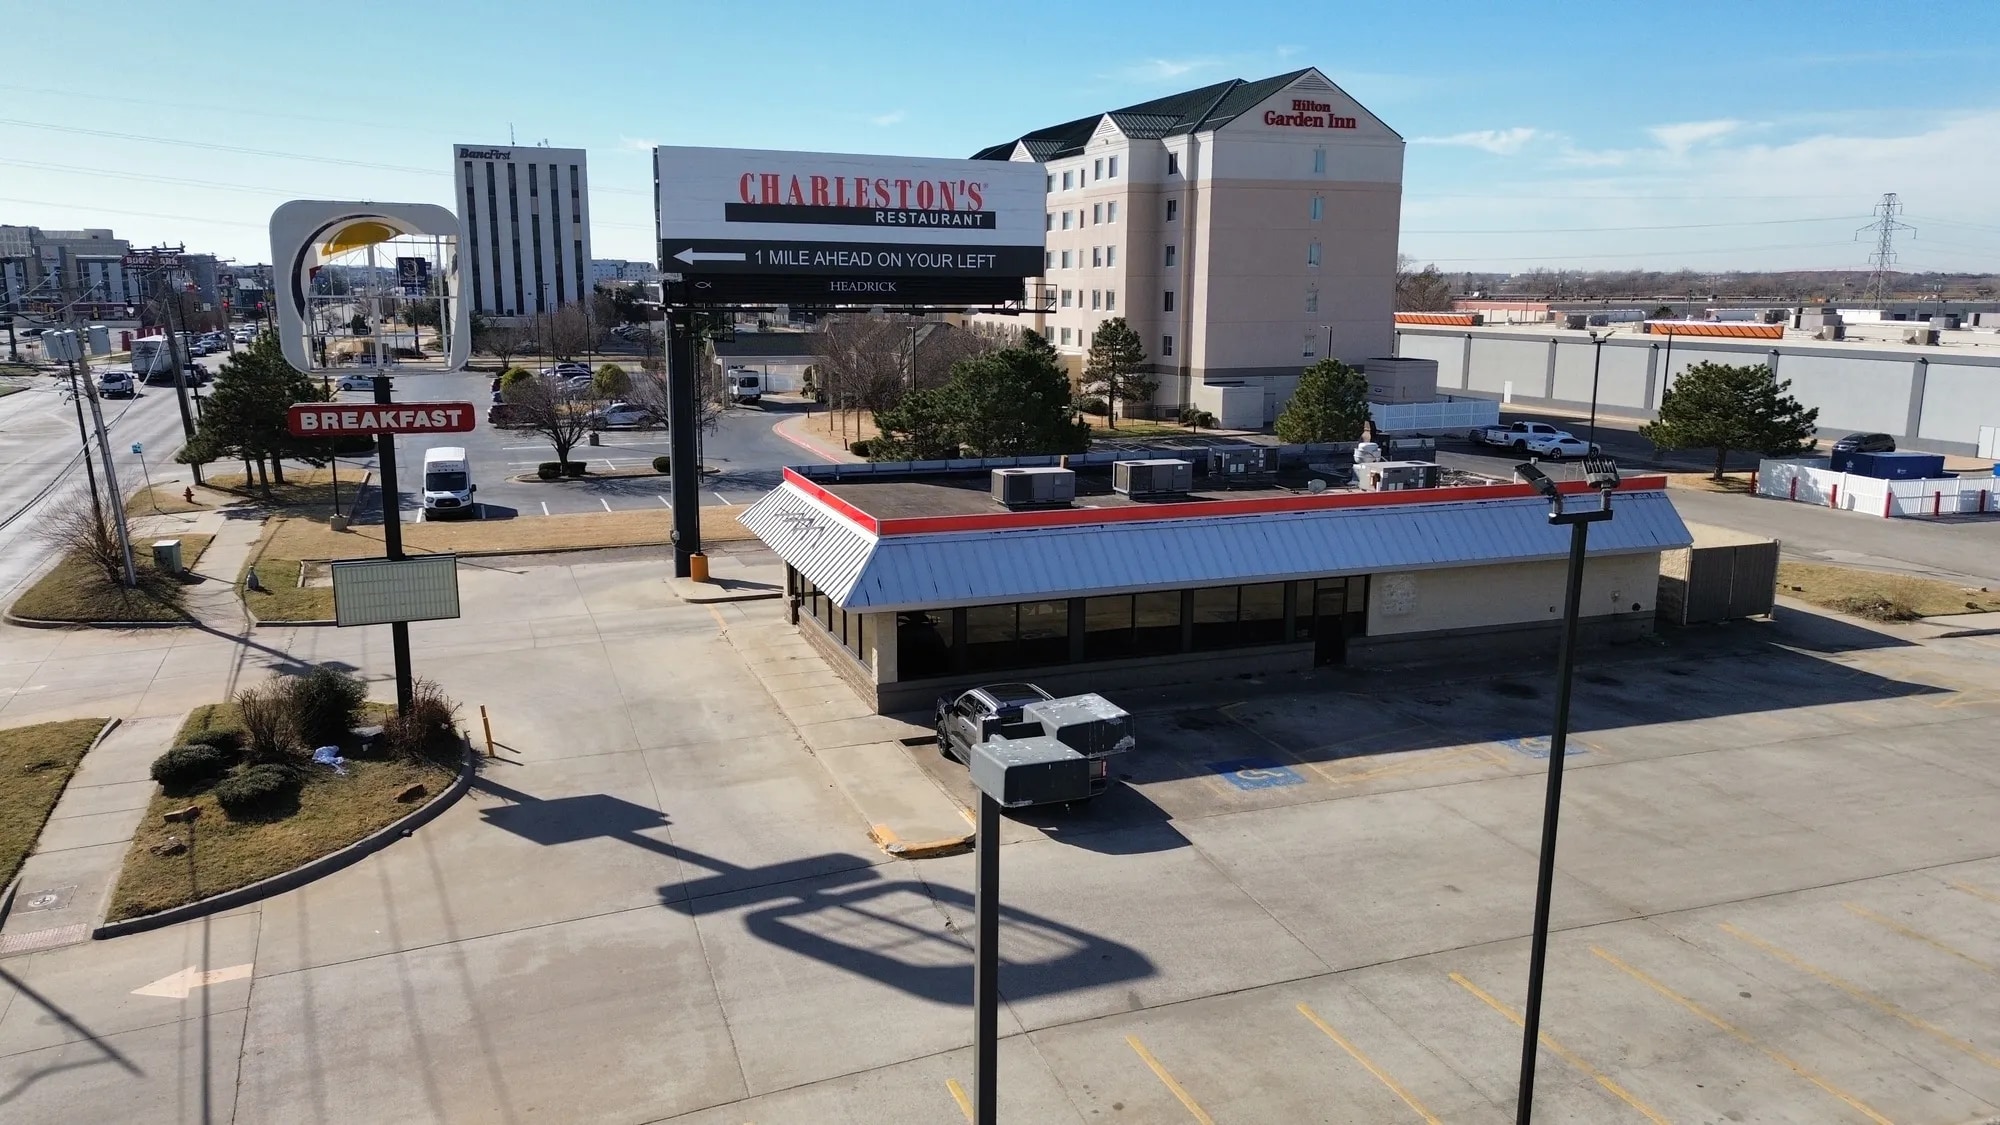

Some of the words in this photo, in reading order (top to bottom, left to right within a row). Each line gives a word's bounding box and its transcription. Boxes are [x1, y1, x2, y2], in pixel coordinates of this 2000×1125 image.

[1292, 99, 1331, 112] Hilton
[1264, 110, 1324, 128] Garden
[1328, 113, 1356, 128] Inn
[460, 148, 511, 160] BancFirst
[740, 172, 984, 212] CHARLESTON'S
[875, 211, 983, 226] RESTAURANT
[755, 250, 762, 265] 1
[769, 250, 810, 266] MILE
[813, 251, 873, 267] AHEAD
[877, 252, 902, 267] ON
[906, 253, 953, 268] YOUR
[958, 254, 996, 269] LEFT
[830, 281, 897, 292] HEADRICK
[300, 409, 462, 430] BREAKFAST
